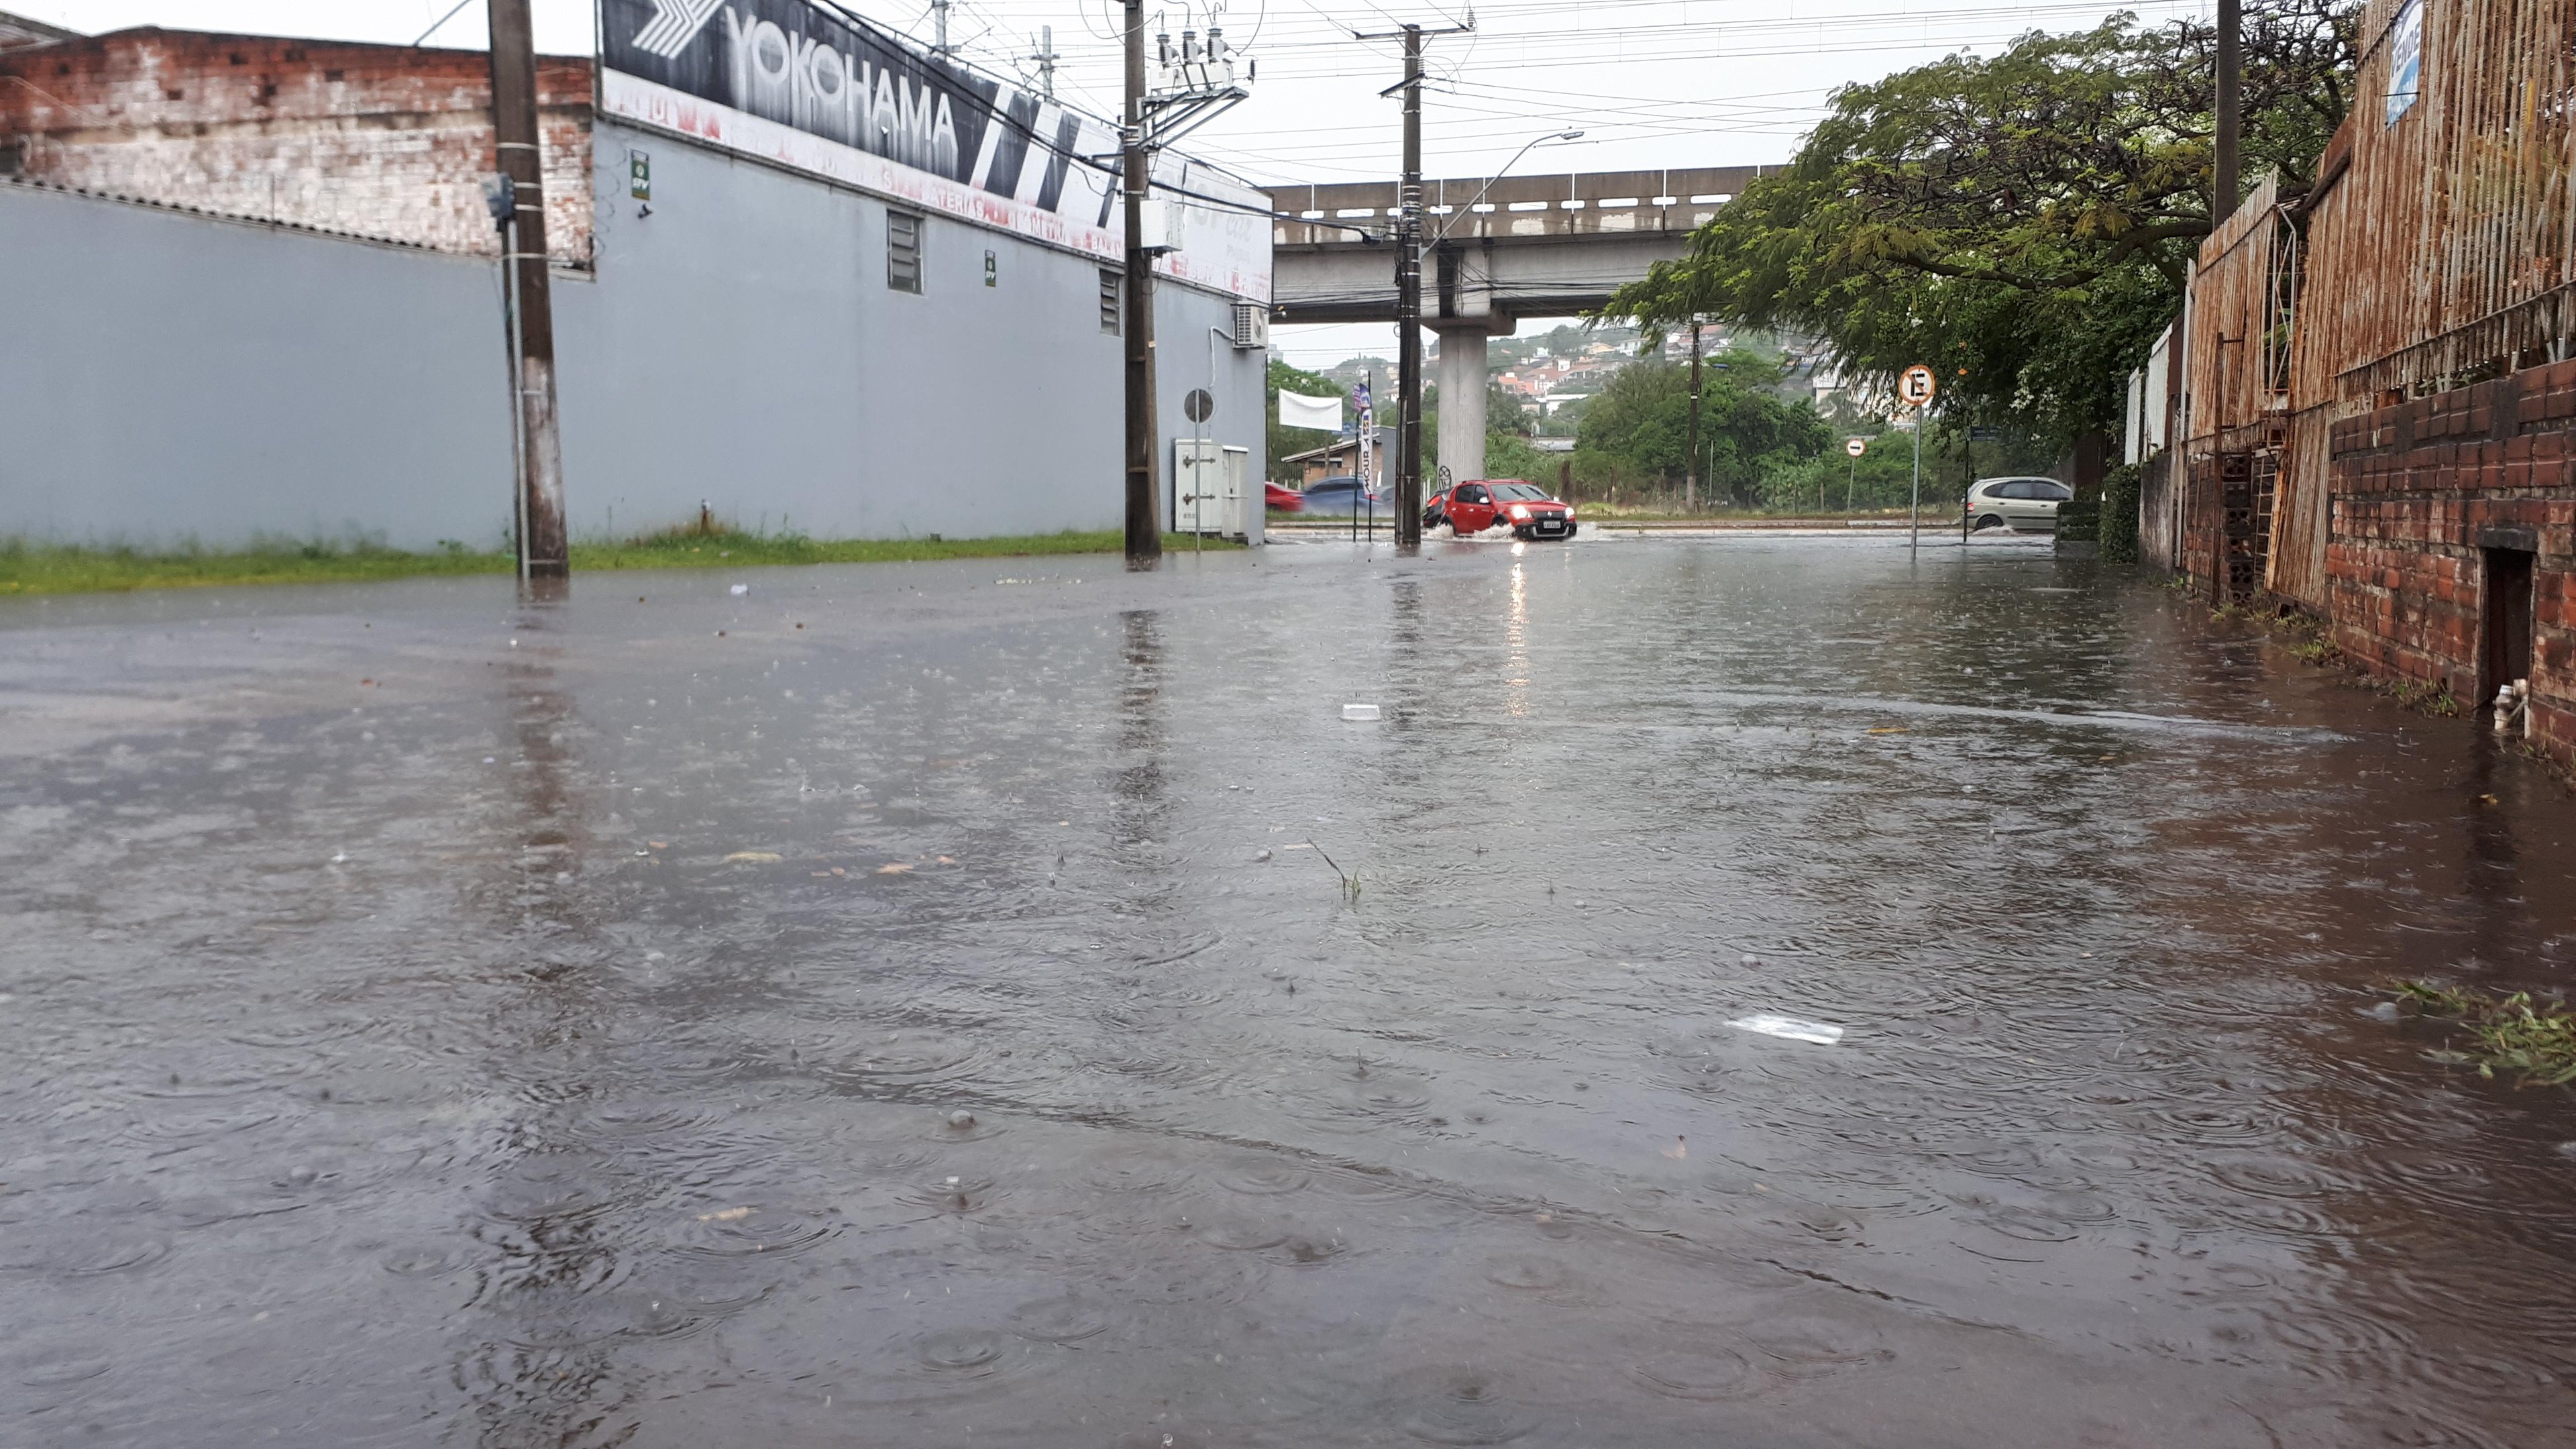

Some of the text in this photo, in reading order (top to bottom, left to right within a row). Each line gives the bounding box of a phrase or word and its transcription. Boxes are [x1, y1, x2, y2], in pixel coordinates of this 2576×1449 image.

[2392, 21, 2420, 78] VENDE
[725, 5, 958, 154] YOKOHAMA
[1911, 374, 1927, 396] E
